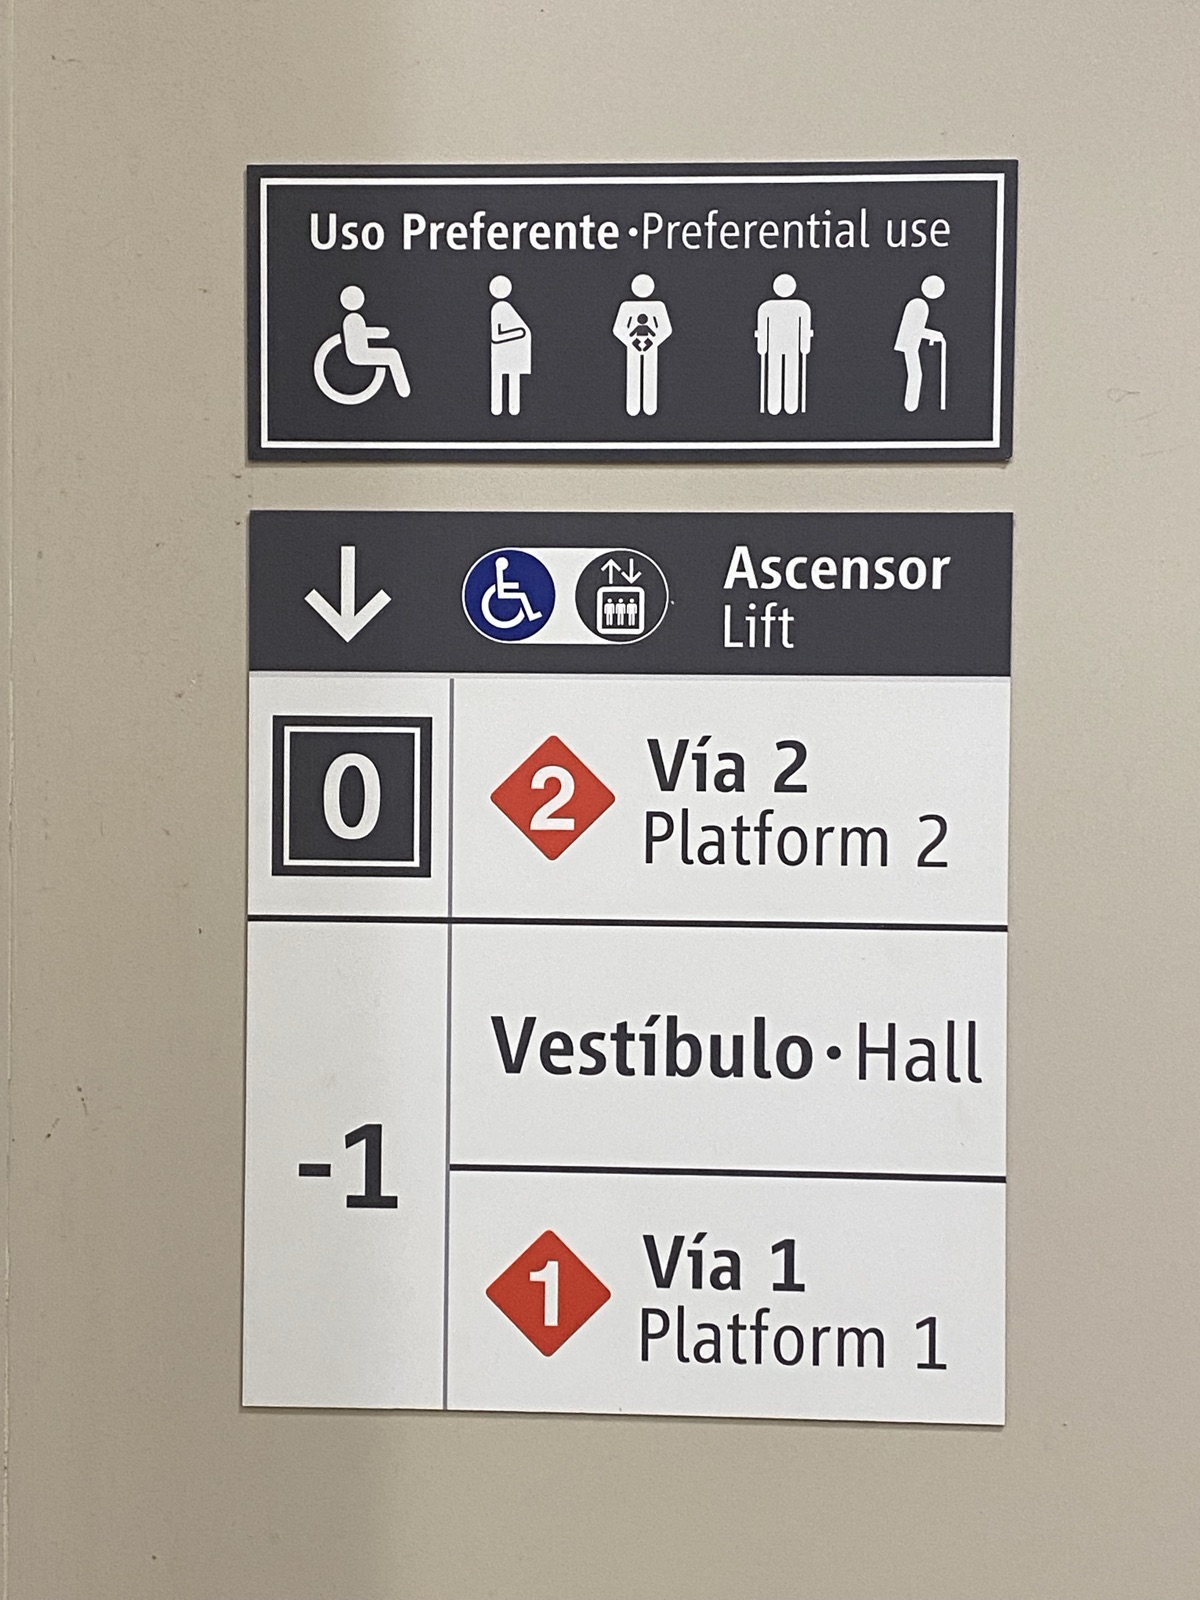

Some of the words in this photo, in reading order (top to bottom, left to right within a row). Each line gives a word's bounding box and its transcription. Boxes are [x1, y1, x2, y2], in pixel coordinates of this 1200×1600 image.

[309, 213, 385, 251] Uso
[402, 210, 621, 251] Preferente
[642, 207, 870, 250] Preferential
[886, 218, 951, 248] use
[723, 545, 952, 590] Ascensor
[723, 601, 795, 650] Lift
[323, 752, 381, 840] 0
[646, 734, 745, 793] Vía
[773, 739, 808, 794] 2
[529, 765, 575, 832] 2
[645, 807, 888, 867] Platform
[917, 814, 949, 868] 2
[490, 1013, 813, 1080] Vestíbulo
[858, 1019, 983, 1084] Hall
[298, 1123, 399, 1209] -1
[528, 1259, 562, 1328] 1
[642, 1231, 741, 1291] Vía
[770, 1238, 806, 1293] 1
[641, 1304, 885, 1369] Platform
[915, 1316, 948, 1370] 1
